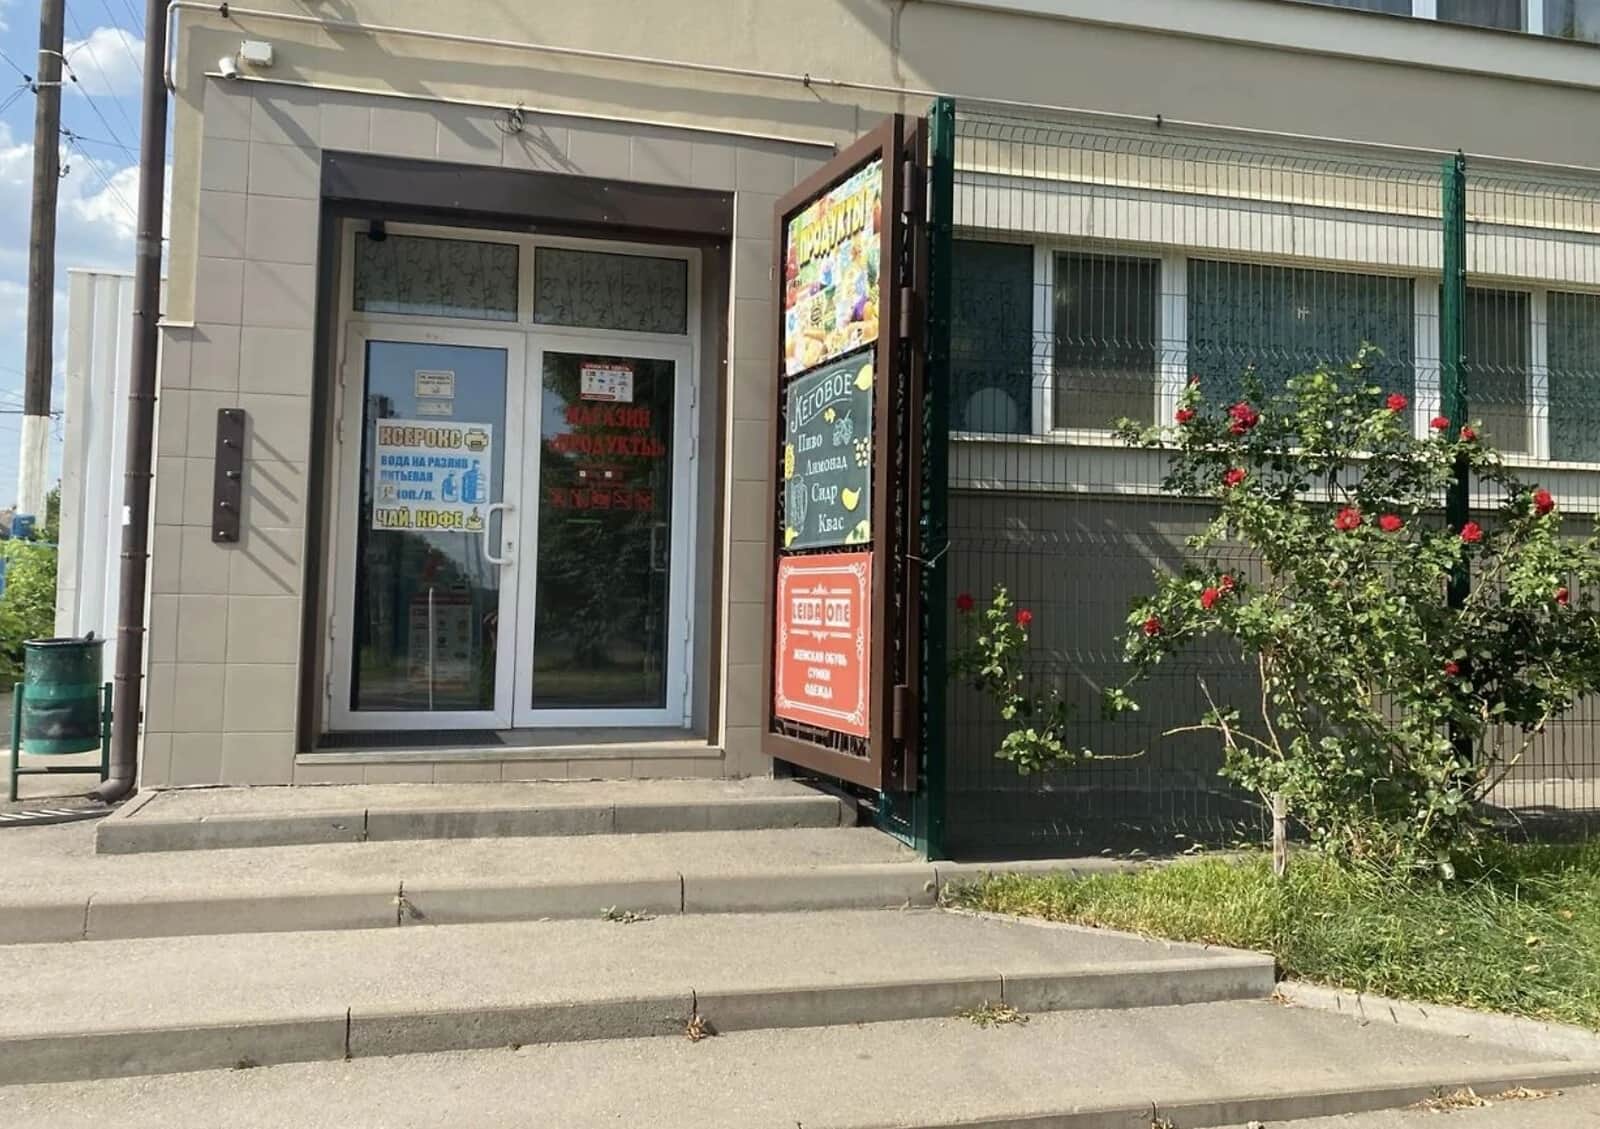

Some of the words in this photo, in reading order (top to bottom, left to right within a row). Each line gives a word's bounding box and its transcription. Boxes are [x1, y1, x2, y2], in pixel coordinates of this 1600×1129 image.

[799, 188, 868, 268] ПРОДУКТЫ
[791, 374, 853, 432] КЕГОВОЕ
[567, 406, 650, 428] МАГАЗИН
[379, 426, 461, 448] КСЕРОКС
[798, 433, 823, 452] Пиво
[381, 455, 409, 466] ВОДА
[411, 456, 426, 467] НА
[428, 457, 468, 469] РАЗЛИВ
[380, 470, 433, 482] ПИТЬЕВАЯ
[415, 509, 463, 528] КОФЕ
[818, 513, 845, 533] Квас
